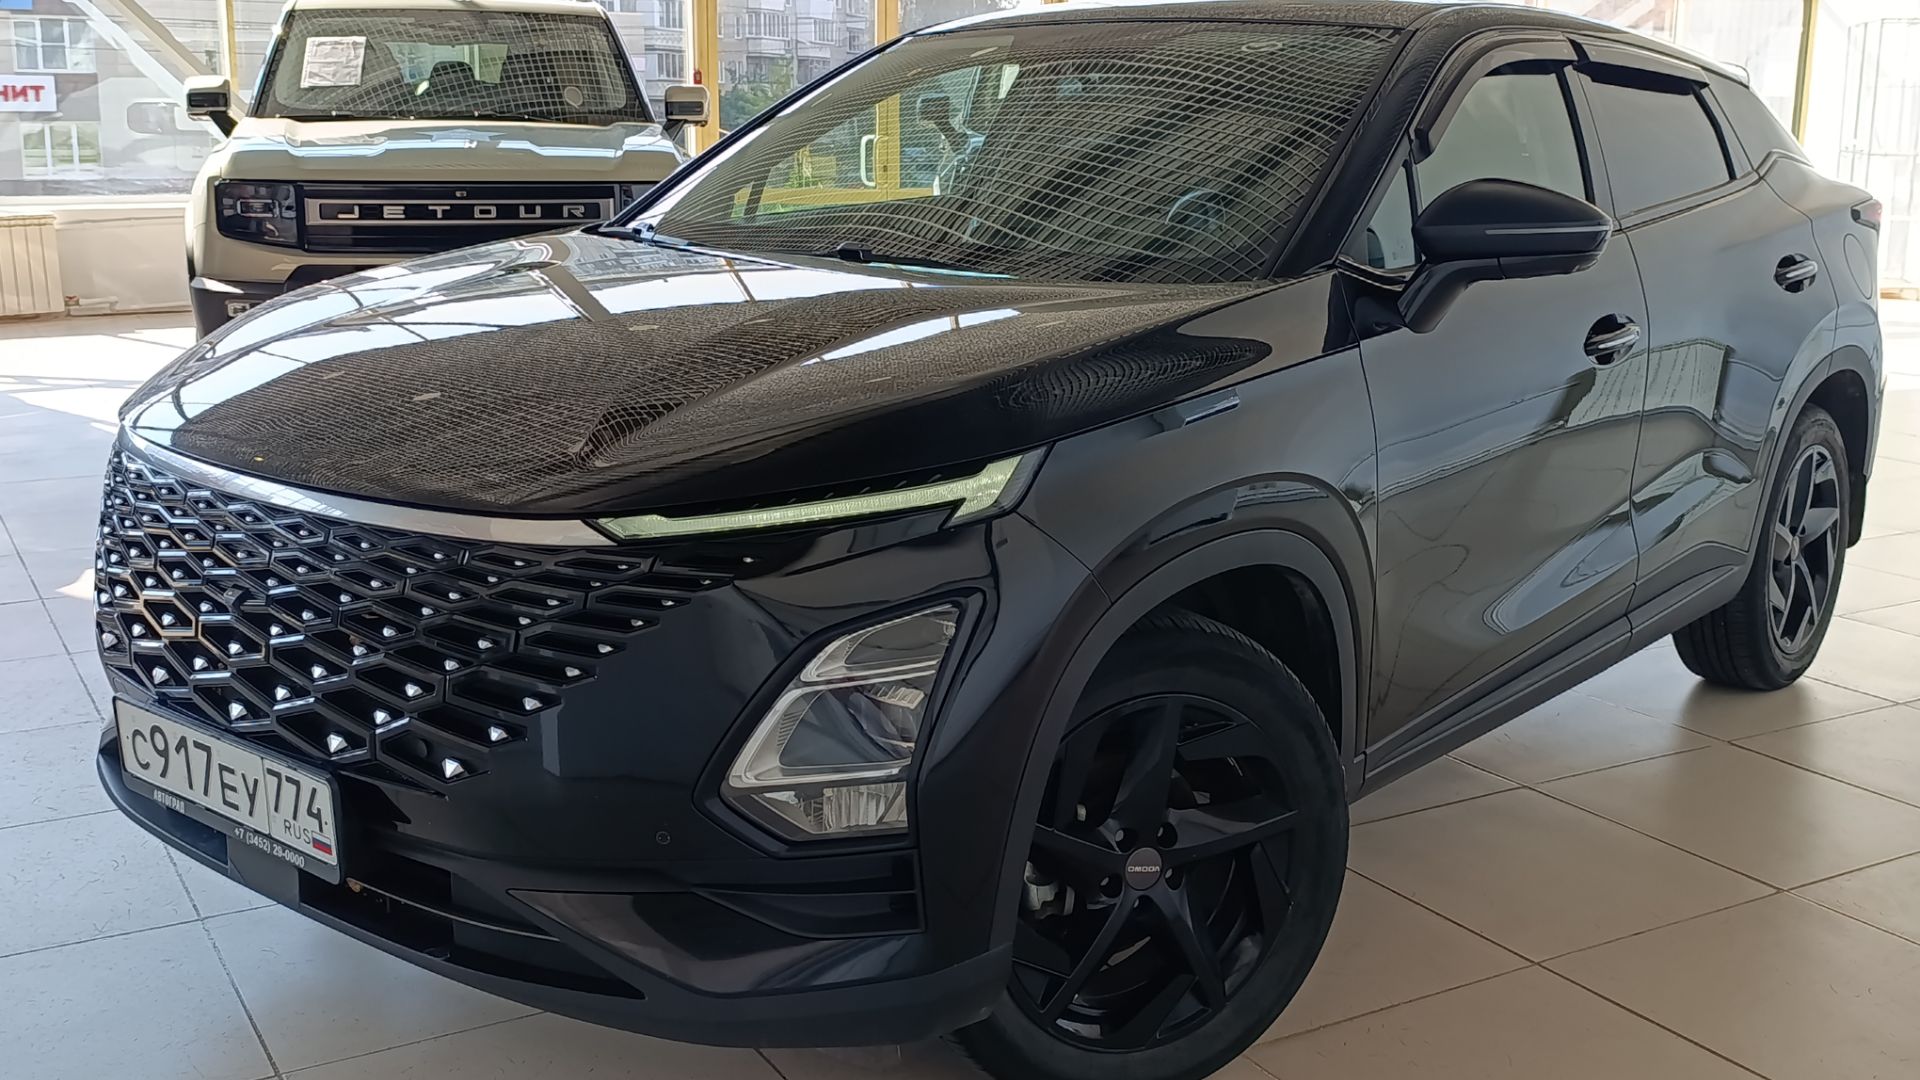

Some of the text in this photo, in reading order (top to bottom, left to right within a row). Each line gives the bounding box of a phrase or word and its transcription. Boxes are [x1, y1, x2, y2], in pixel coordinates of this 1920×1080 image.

[337, 204, 586, 219] JETOUR
[131, 725, 324, 833] С917ЕУ 774
[153, 789, 185, 814] АВТОГРАД
[283, 819, 312, 844] RUS
[234, 827, 305, 868] +7 (3452) 29-0000
